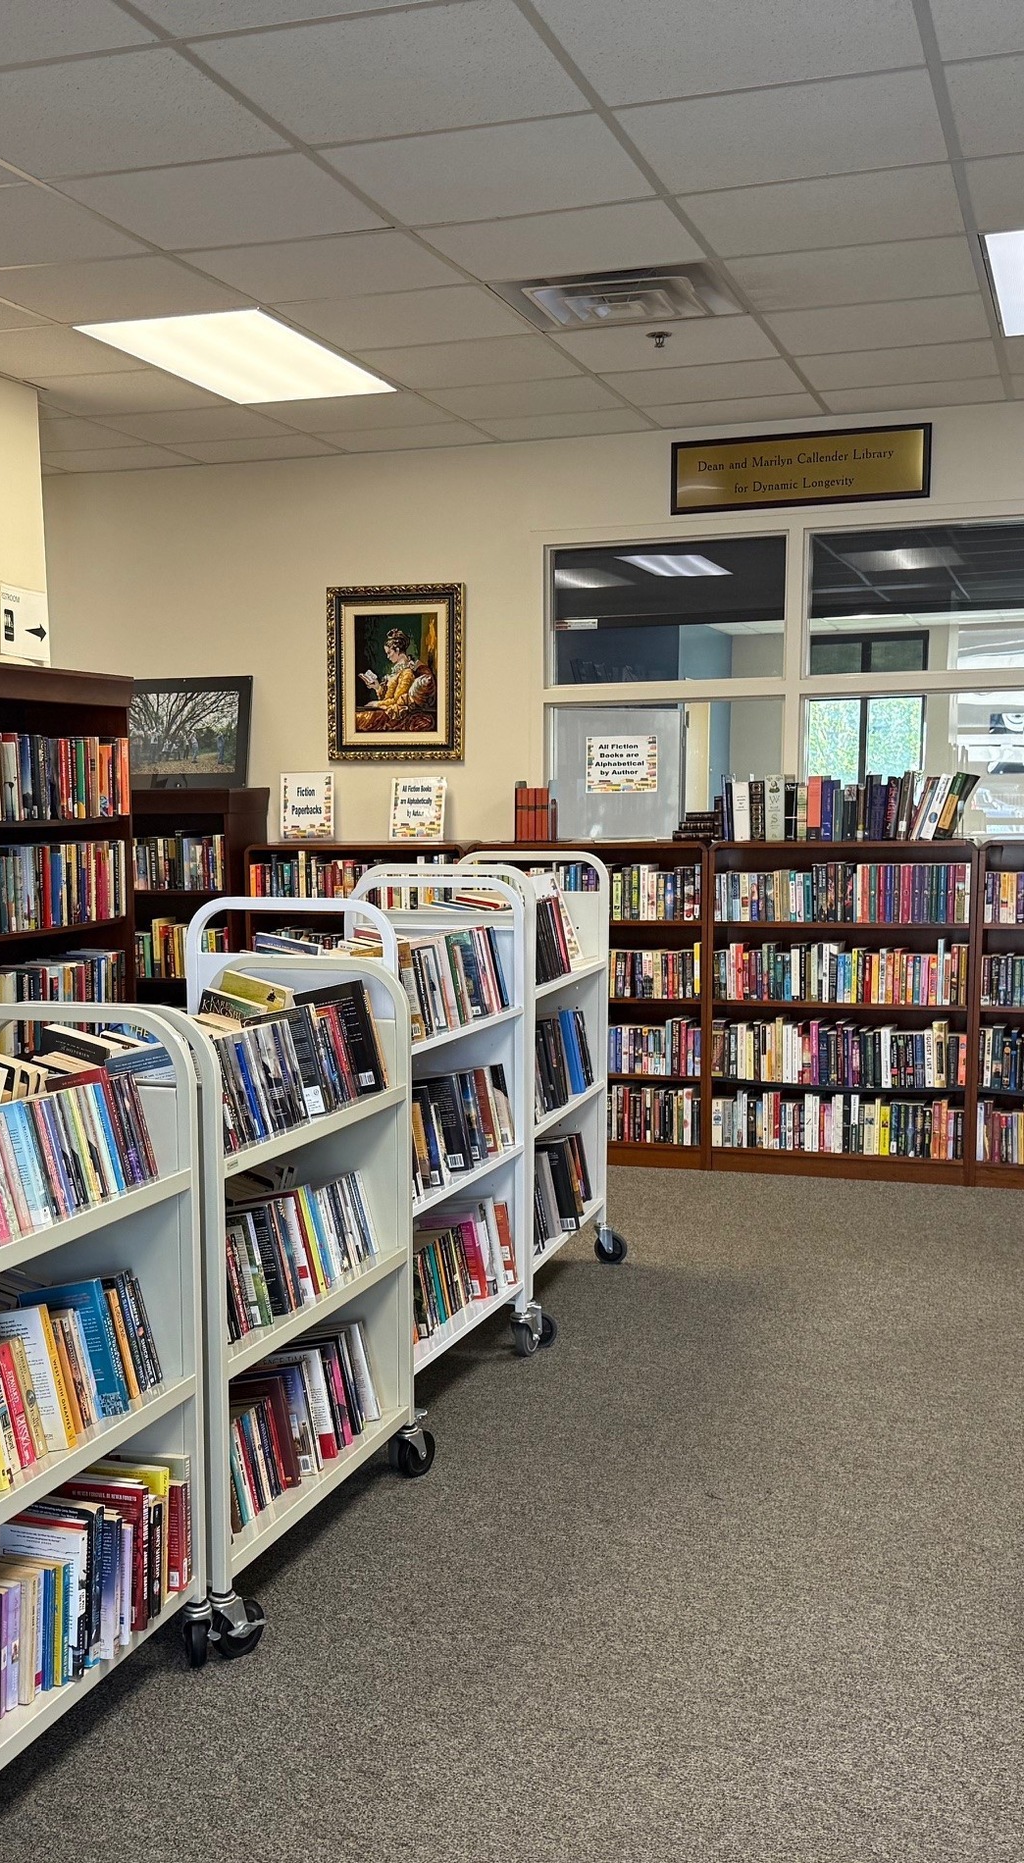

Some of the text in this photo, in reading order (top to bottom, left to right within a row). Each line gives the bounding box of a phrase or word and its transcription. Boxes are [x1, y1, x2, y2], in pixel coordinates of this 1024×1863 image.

[698, 448, 894, 472] Dean and Marilyn Callender Library
[734, 475, 855, 493] for Dynamic Longevity
[297, 787, 315, 797] Fiction
[407, 798, 432, 806] Alphabetically
[291, 805, 322, 817] Paperbacks
[129, 1024, 149, 1038] THE
[52, 1360, 71, 1430] WEST WITH GIRAFFES
